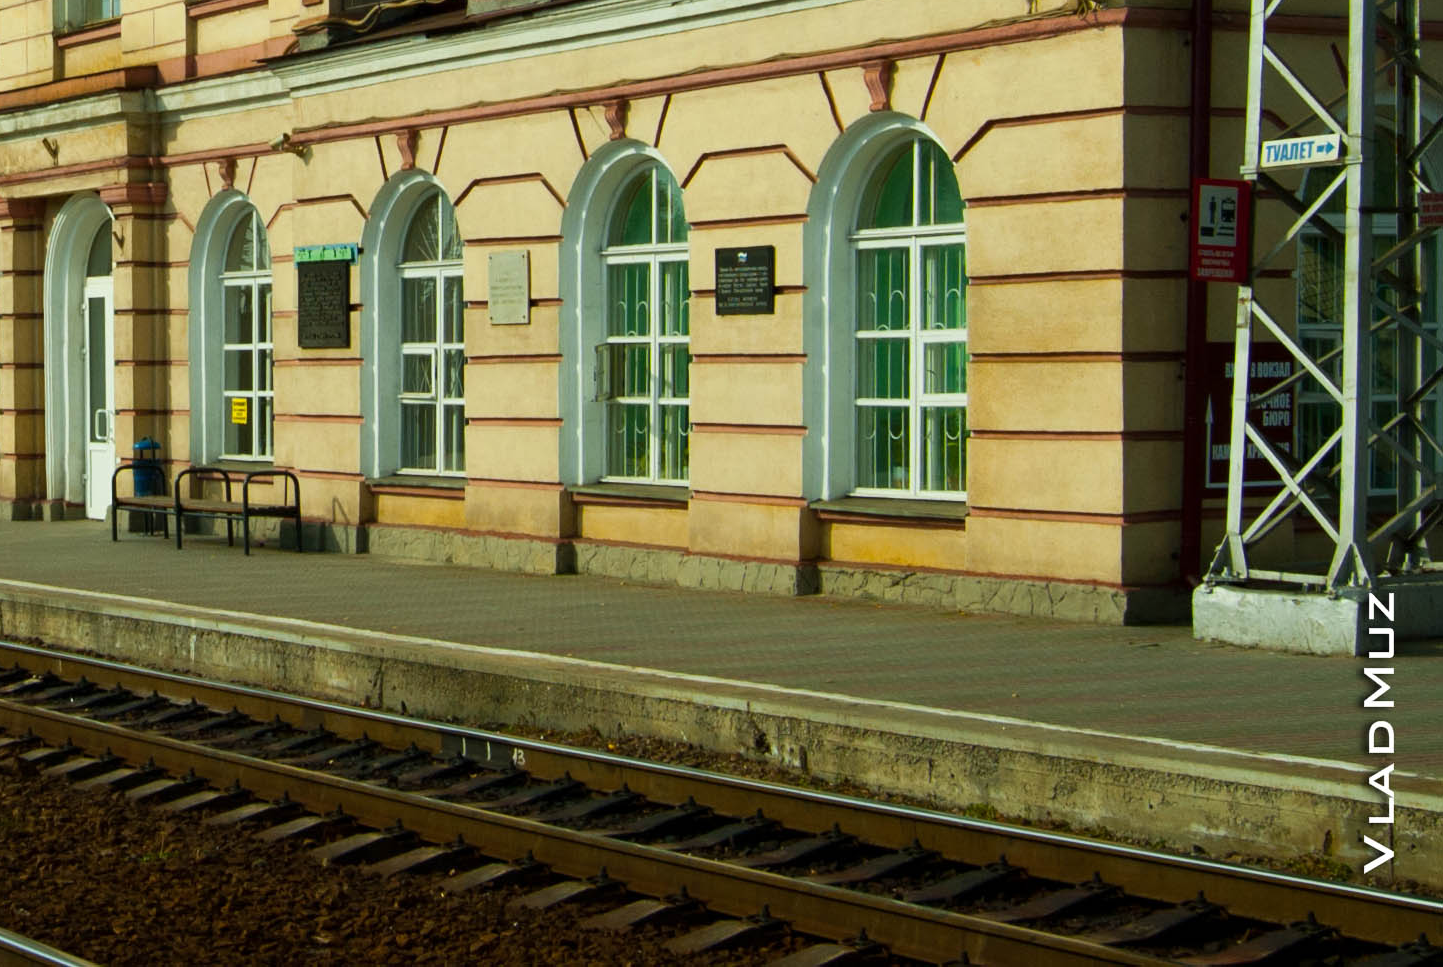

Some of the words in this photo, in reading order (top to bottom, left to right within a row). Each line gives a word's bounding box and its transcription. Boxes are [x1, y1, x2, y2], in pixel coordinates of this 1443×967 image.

[1266, 140, 1315, 163] ТУАЛЕТ
[1257, 362, 1291, 378] ВОКЗАЛ
[1262, 410, 1290, 427] БЮРО
